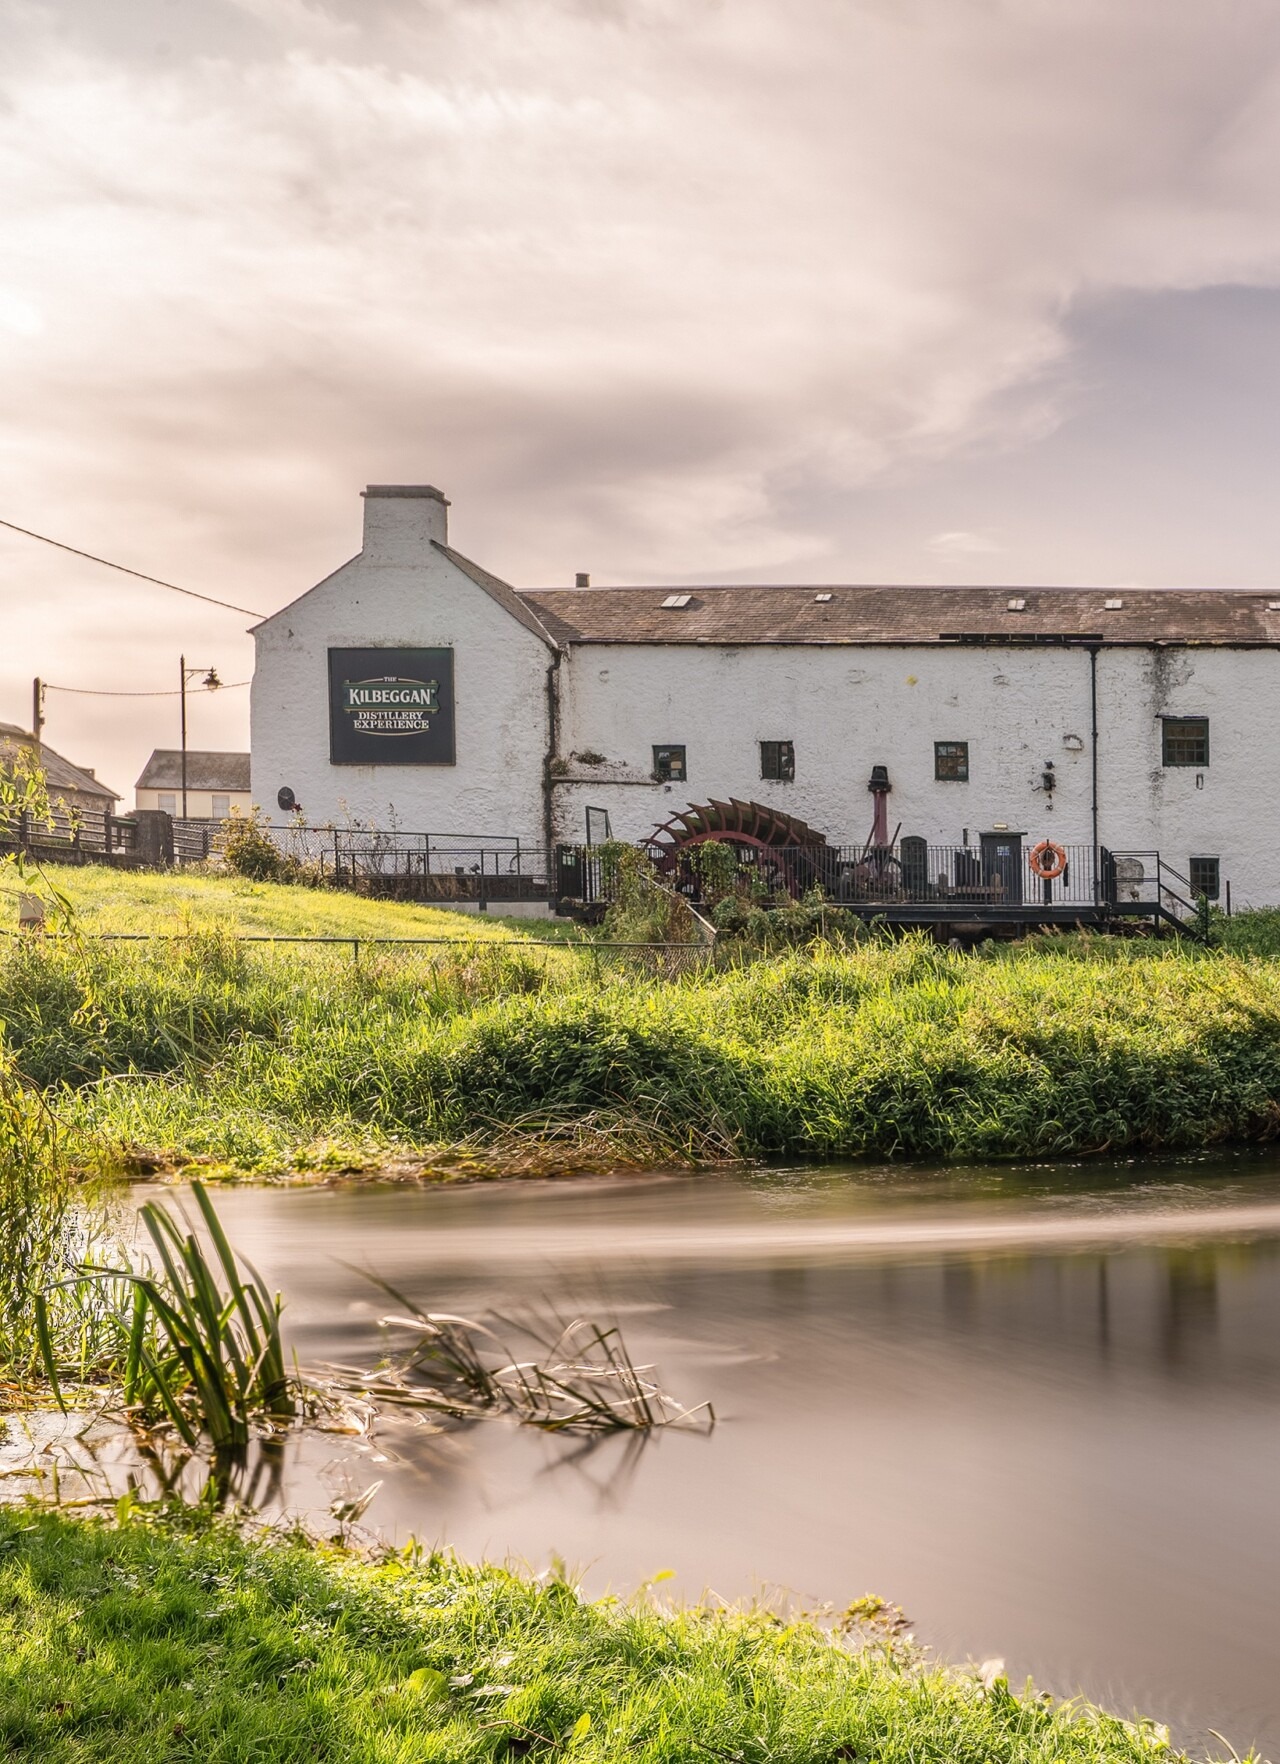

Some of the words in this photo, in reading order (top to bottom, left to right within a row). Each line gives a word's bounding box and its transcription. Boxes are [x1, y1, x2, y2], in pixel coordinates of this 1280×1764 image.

[349, 689, 431, 705] KILBEGGAN
[358, 711, 424, 720] DISTILLERY
[353, 720, 429, 729] EXPERIENCE
